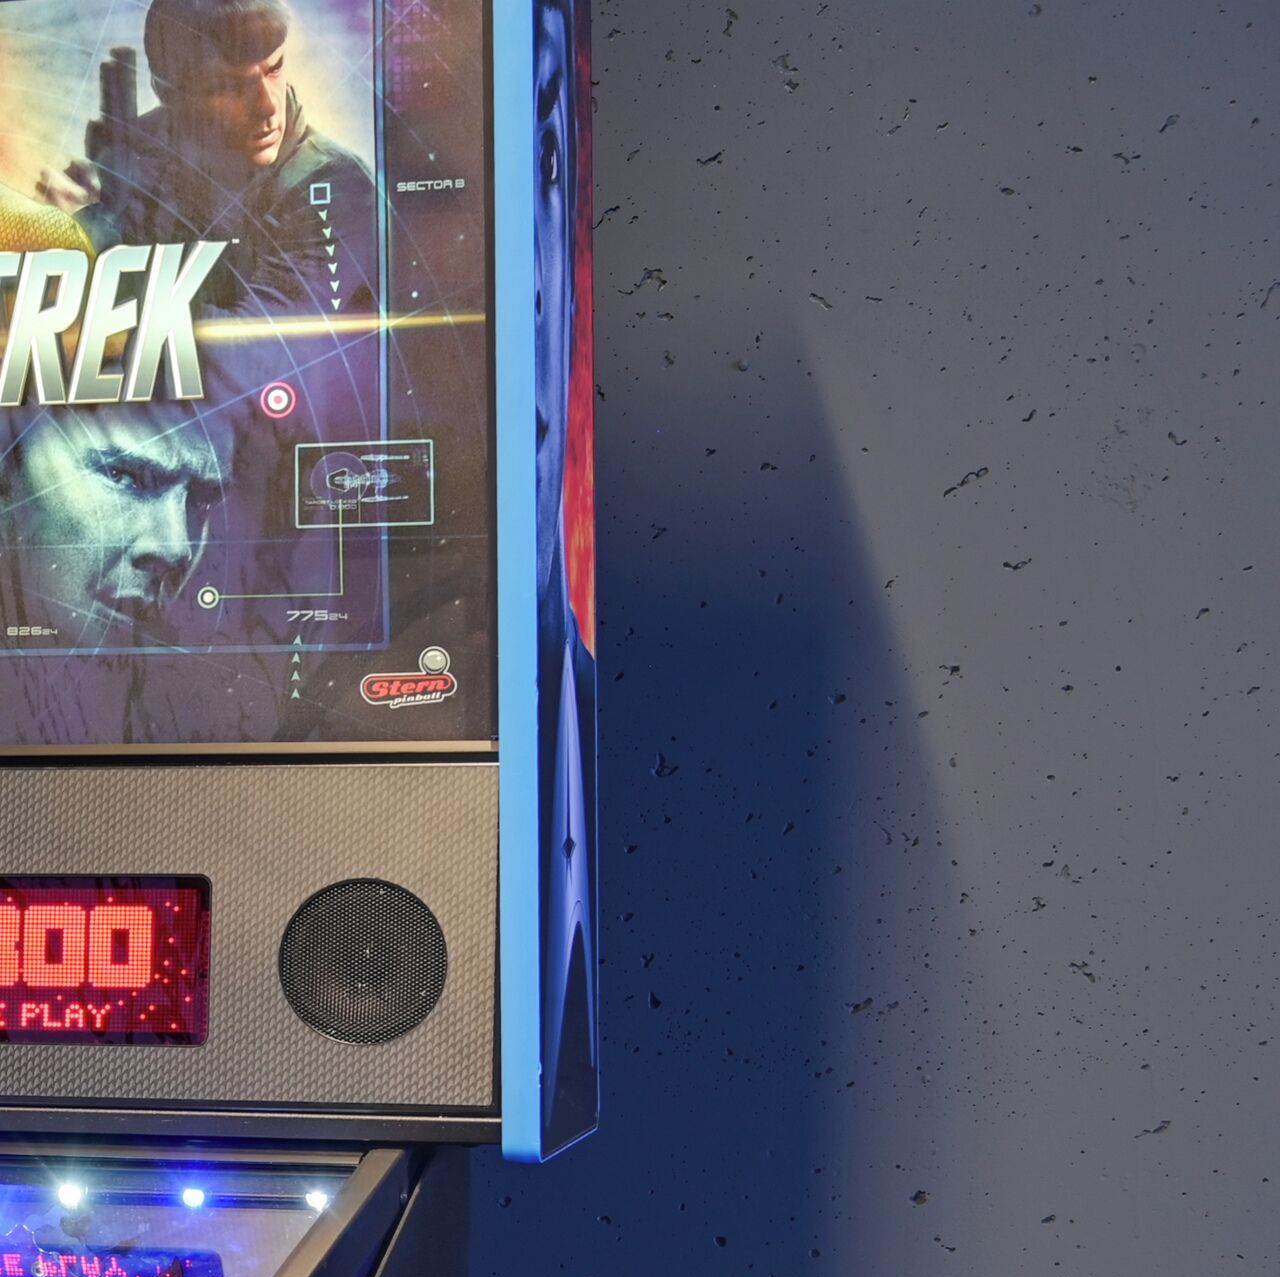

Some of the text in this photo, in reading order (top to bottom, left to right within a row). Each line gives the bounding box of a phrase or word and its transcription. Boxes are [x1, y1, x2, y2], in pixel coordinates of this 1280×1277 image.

[396, 180, 452, 192] SECTOR
[371, 677, 447, 699] Stern
[393, 691, 443, 705] pinball
[20, 1002, 112, 1029] PLAY
